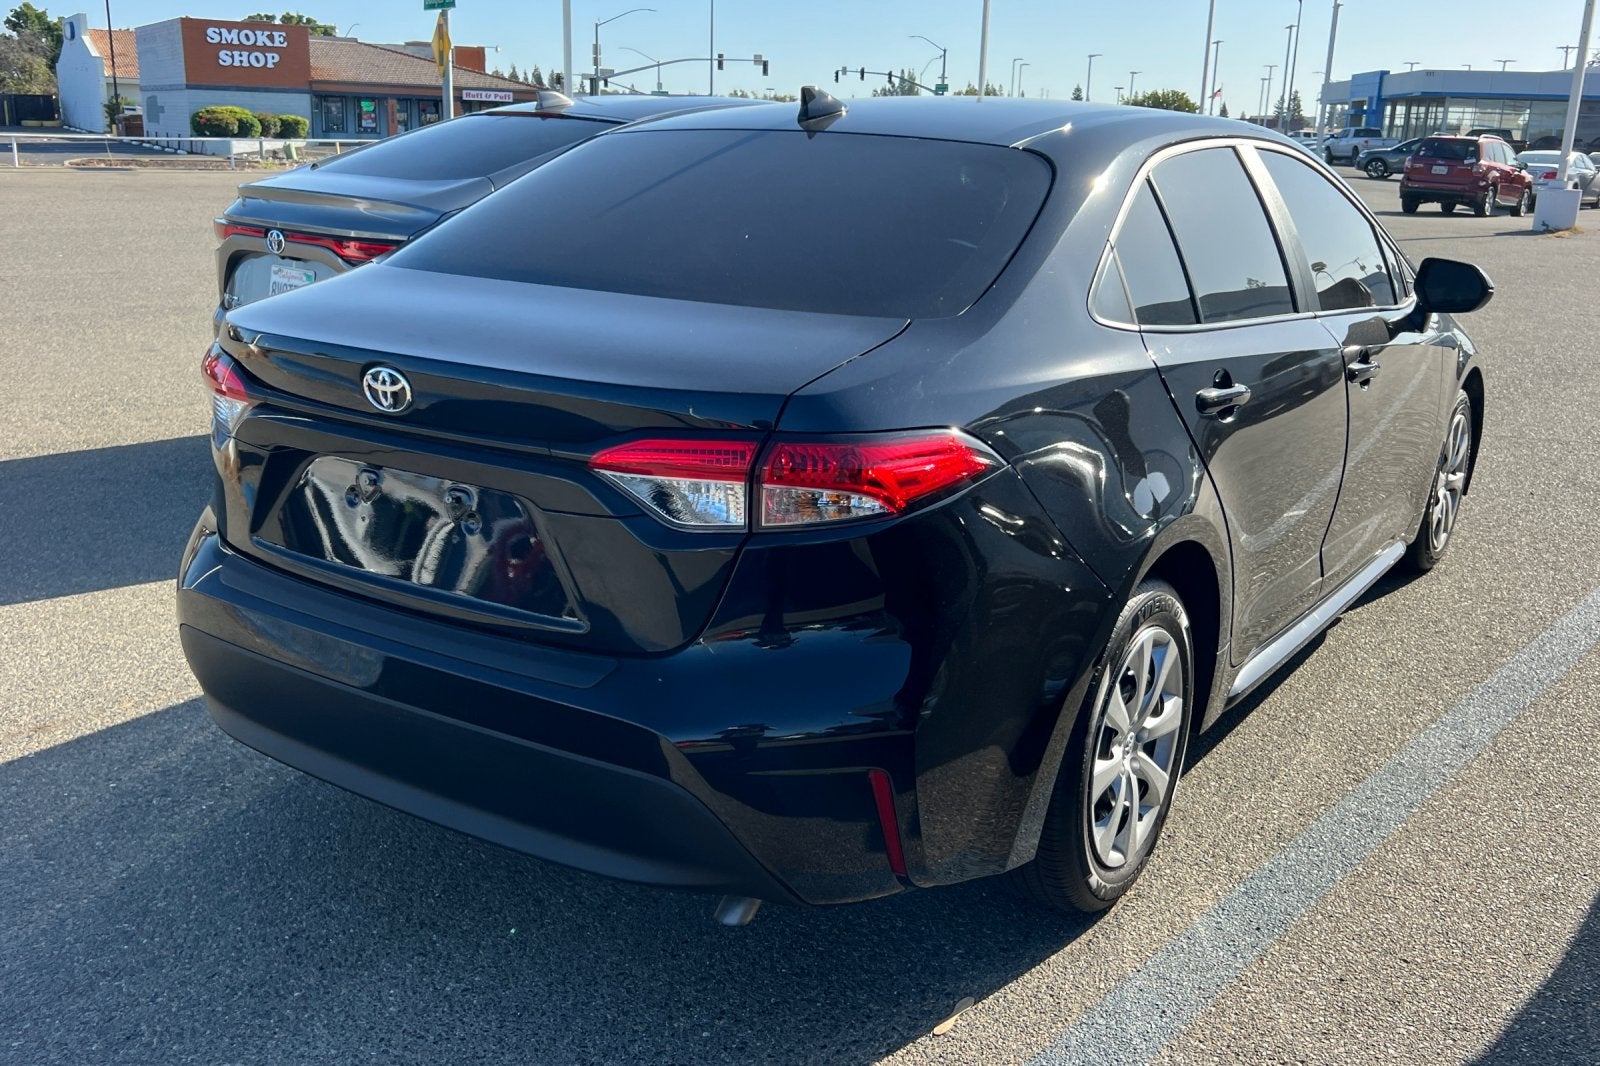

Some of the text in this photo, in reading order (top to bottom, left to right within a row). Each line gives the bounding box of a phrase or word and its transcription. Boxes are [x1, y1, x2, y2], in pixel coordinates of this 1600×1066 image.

[206, 27, 288, 48] SMOKE
[218, 49, 280, 69] SHOP
[465, 91, 483, 99] Huff
